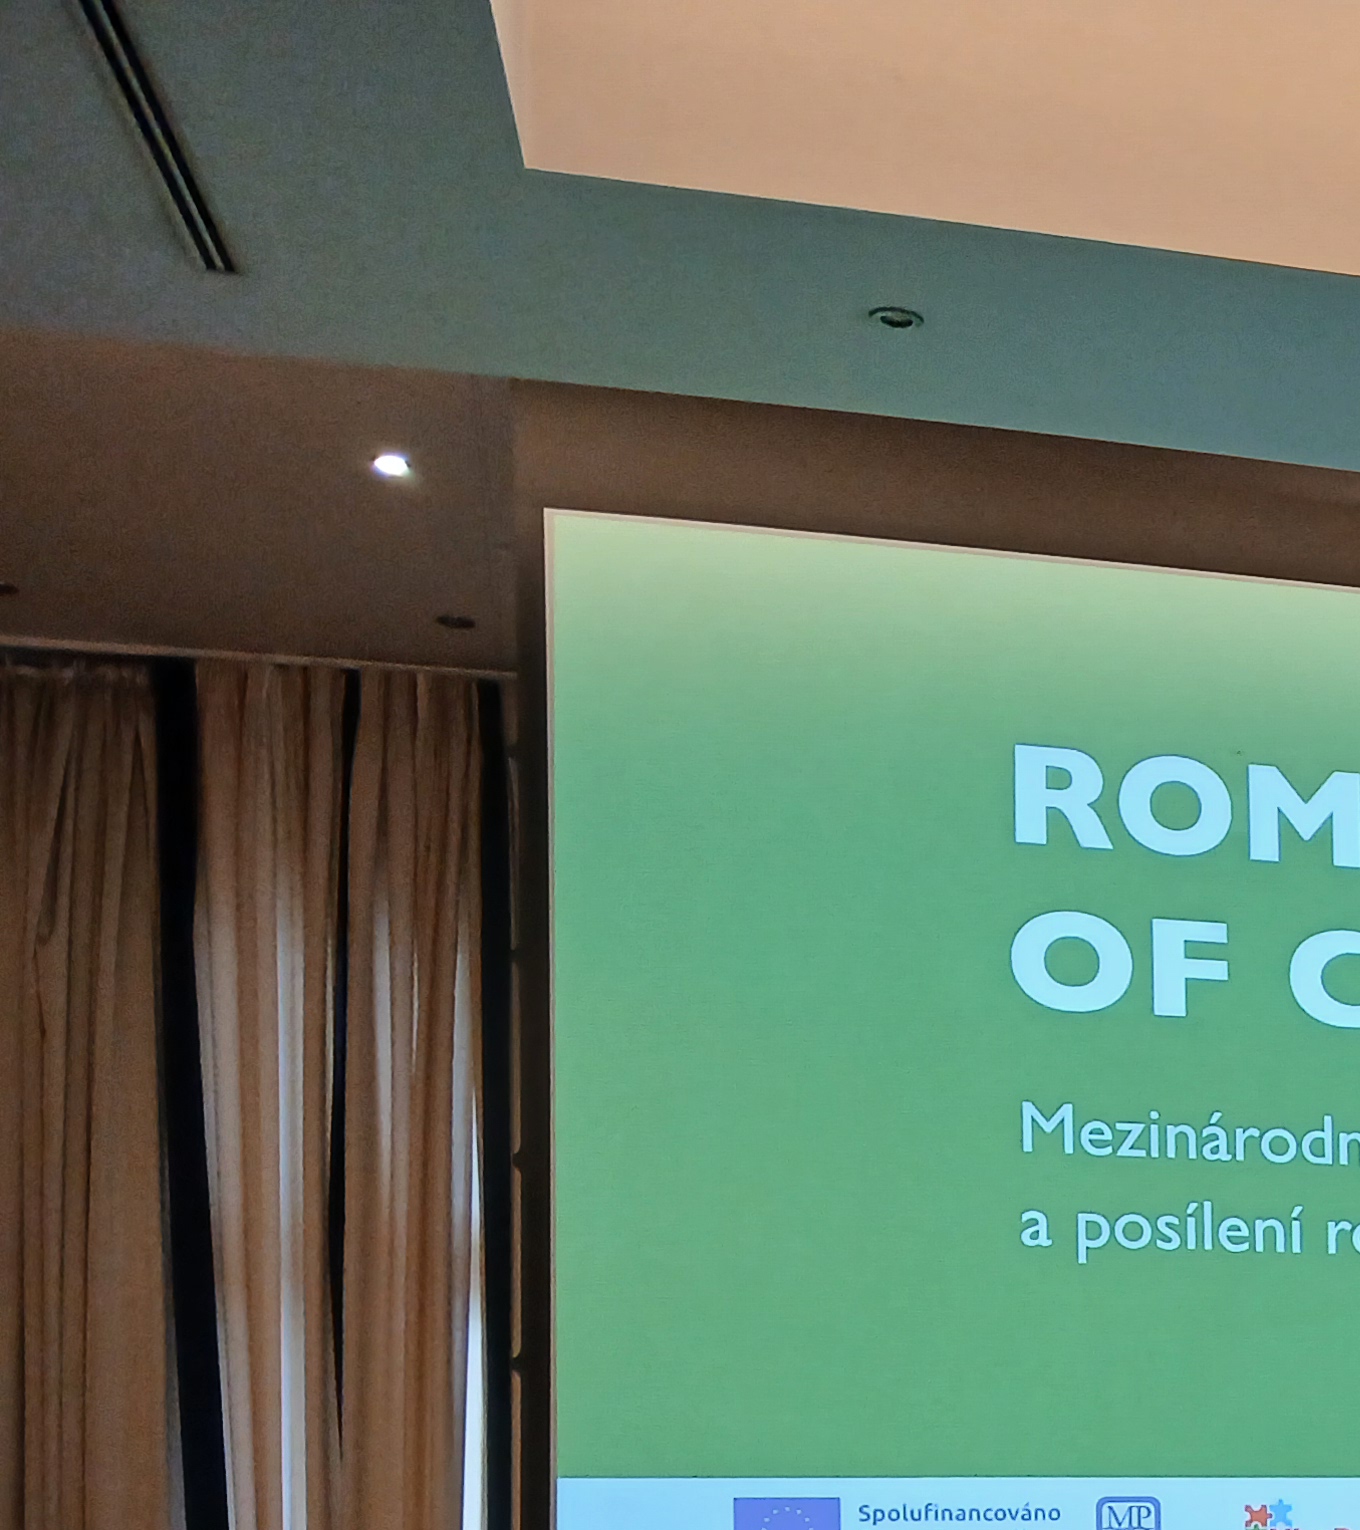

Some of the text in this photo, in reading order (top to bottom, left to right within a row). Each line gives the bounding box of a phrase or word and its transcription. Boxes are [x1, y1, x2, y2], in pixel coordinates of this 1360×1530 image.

[1011, 911, 1228, 1016] OF
[1021, 1211, 1052, 1246] a
[1078, 1201, 1303, 1263] posílení
[859, 1503, 1060, 1525] Spolufinancováno
